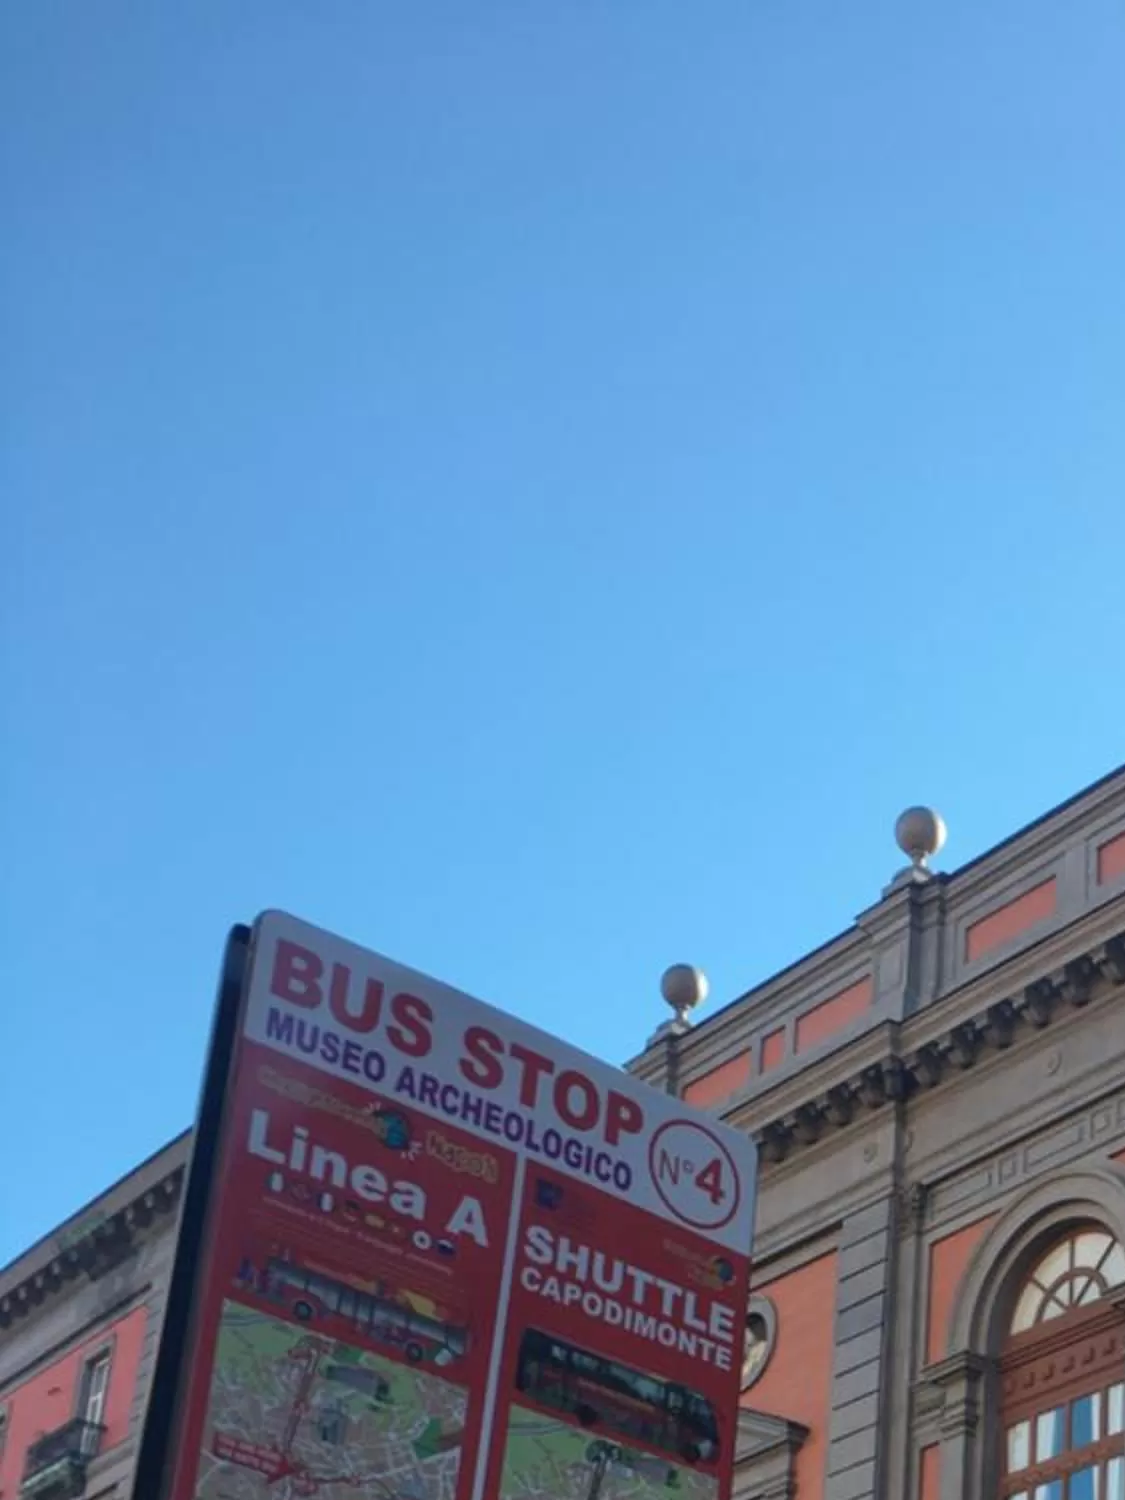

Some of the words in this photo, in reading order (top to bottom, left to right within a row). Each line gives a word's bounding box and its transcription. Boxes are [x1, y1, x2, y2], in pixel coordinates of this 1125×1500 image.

[266, 1006, 386, 1084] MUSEO
[394, 1066, 632, 1191] ARCHEOLOGICO
[269, 938, 433, 1058] BUS
[459, 1024, 644, 1147] STOP
[247, 1108, 427, 1221] Linea
[445, 1195, 489, 1248] A
[520, 1267, 732, 1372] CAPODIMONTE
[524, 1225, 736, 1344] SHUTTLE
